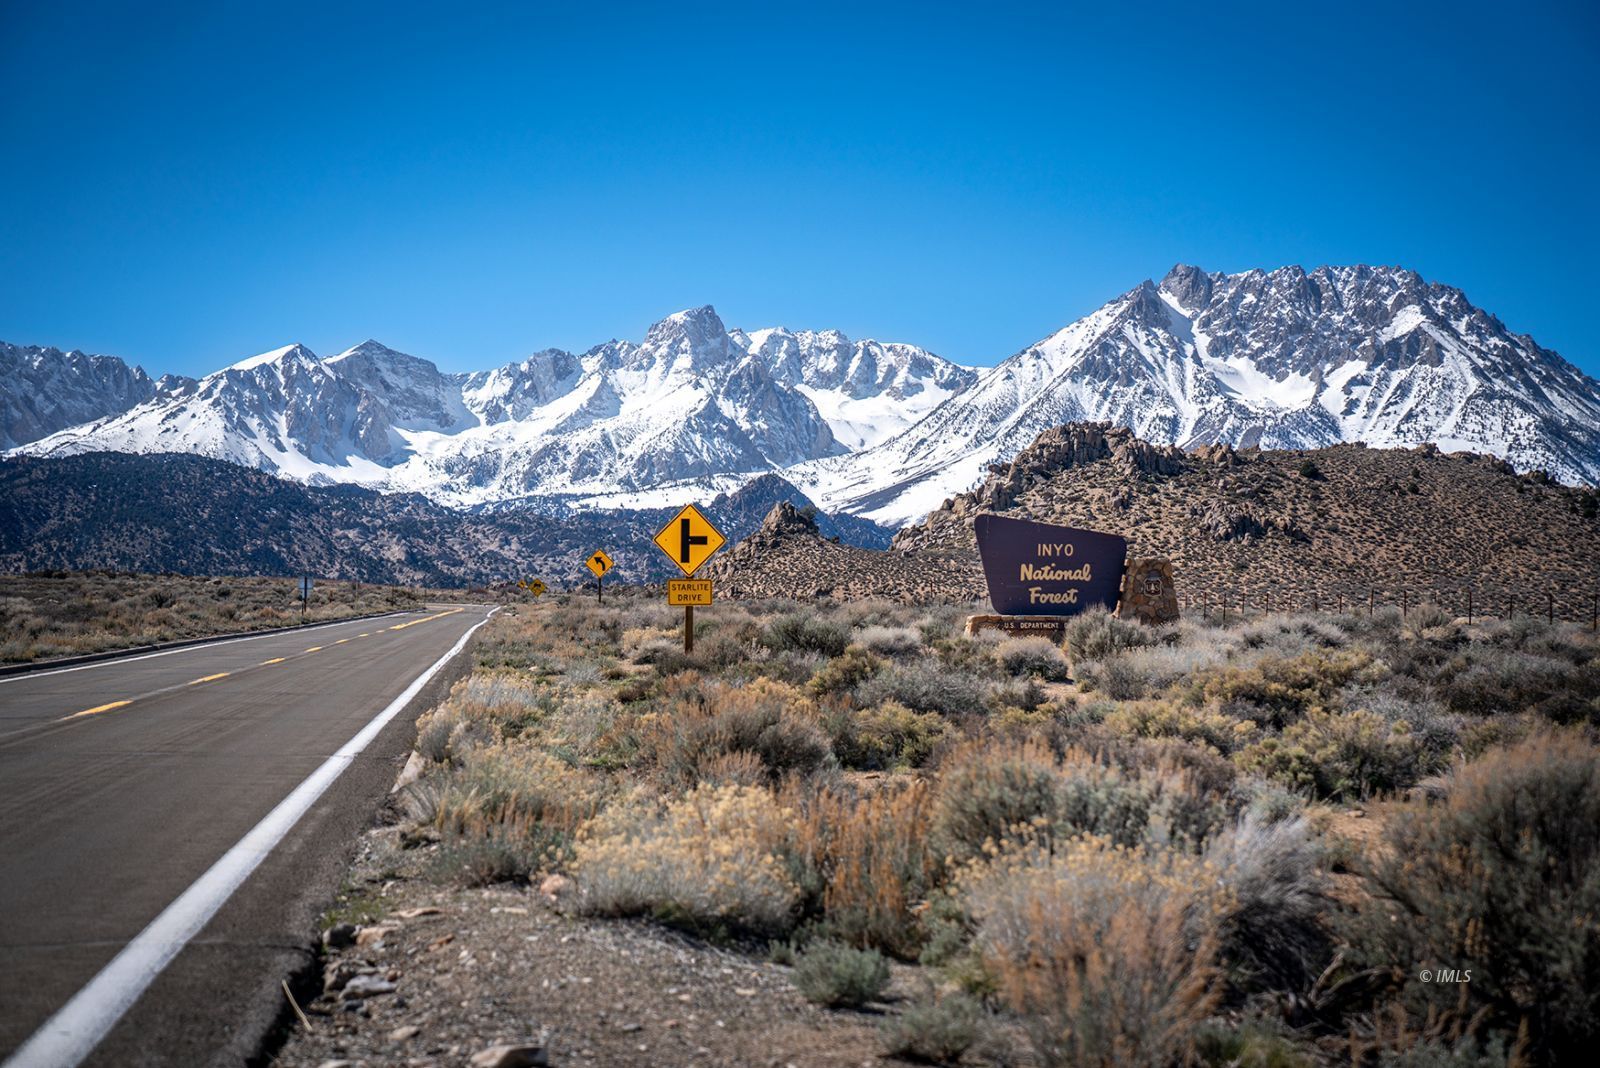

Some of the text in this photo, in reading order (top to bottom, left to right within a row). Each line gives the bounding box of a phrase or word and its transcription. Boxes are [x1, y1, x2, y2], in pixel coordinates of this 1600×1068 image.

[1037, 543, 1074, 557] INYO
[1019, 562, 1091, 582] National
[671, 583, 709, 591] STARLITE
[677, 594, 703, 602] DRIVE
[1028, 586, 1078, 605] Forest
